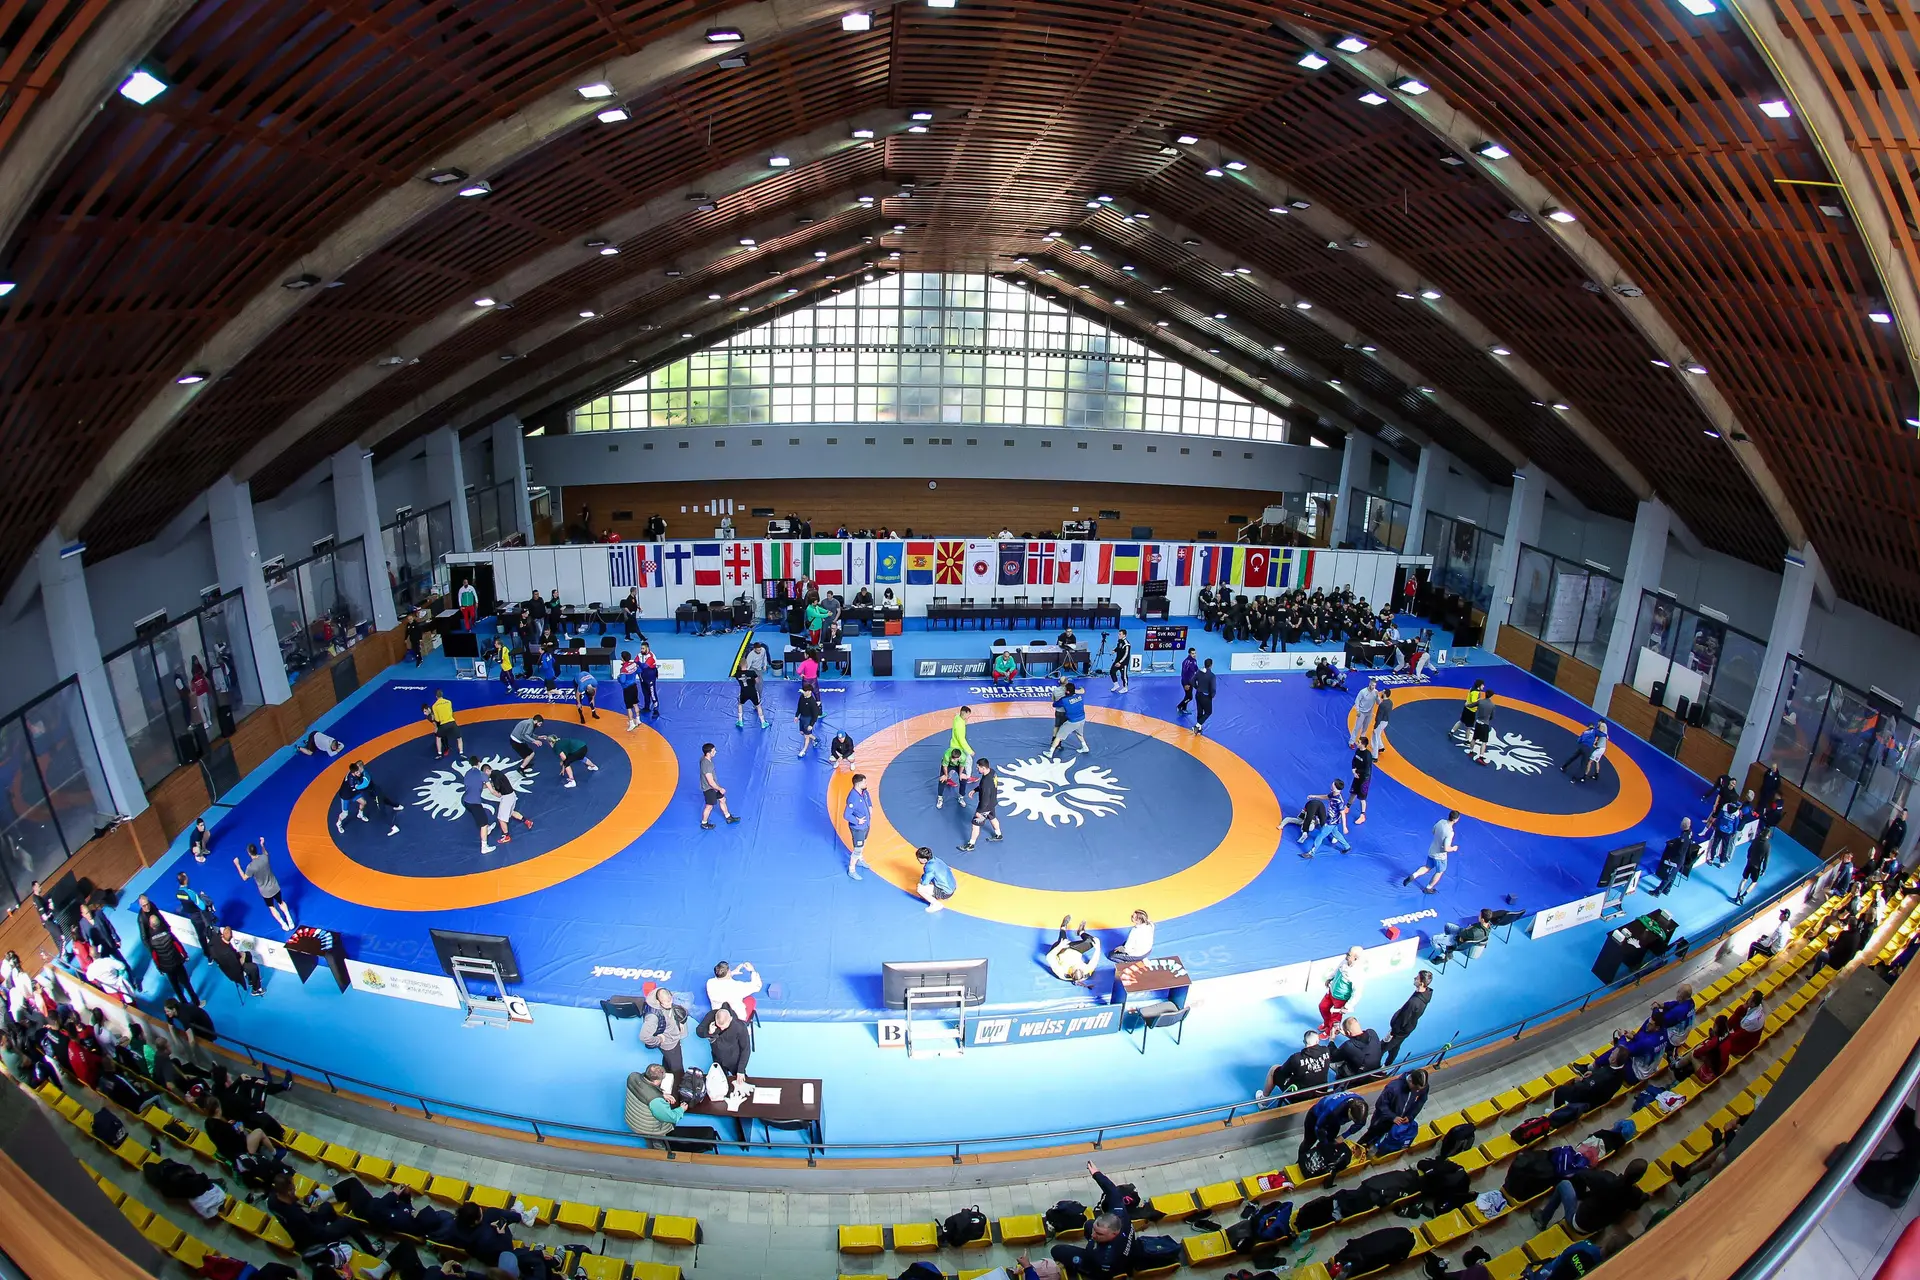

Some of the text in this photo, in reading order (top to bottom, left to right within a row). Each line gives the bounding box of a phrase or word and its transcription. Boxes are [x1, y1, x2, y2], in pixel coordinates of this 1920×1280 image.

[476, 664, 485, 675] C
[940, 662, 962, 674] weiss
[964, 662, 986, 676] profil
[1132, 658, 1140, 668] B
[1380, 908, 1437, 928] foeldeak
[591, 965, 672, 981] foeldeak
[510, 1002, 528, 1016] C
[1019, 1020, 1064, 1036] weiss
[1065, 1012, 1113, 1035] profil
[884, 1025, 901, 1040] B
[1572, 1253, 1585, 1276] UKRA
